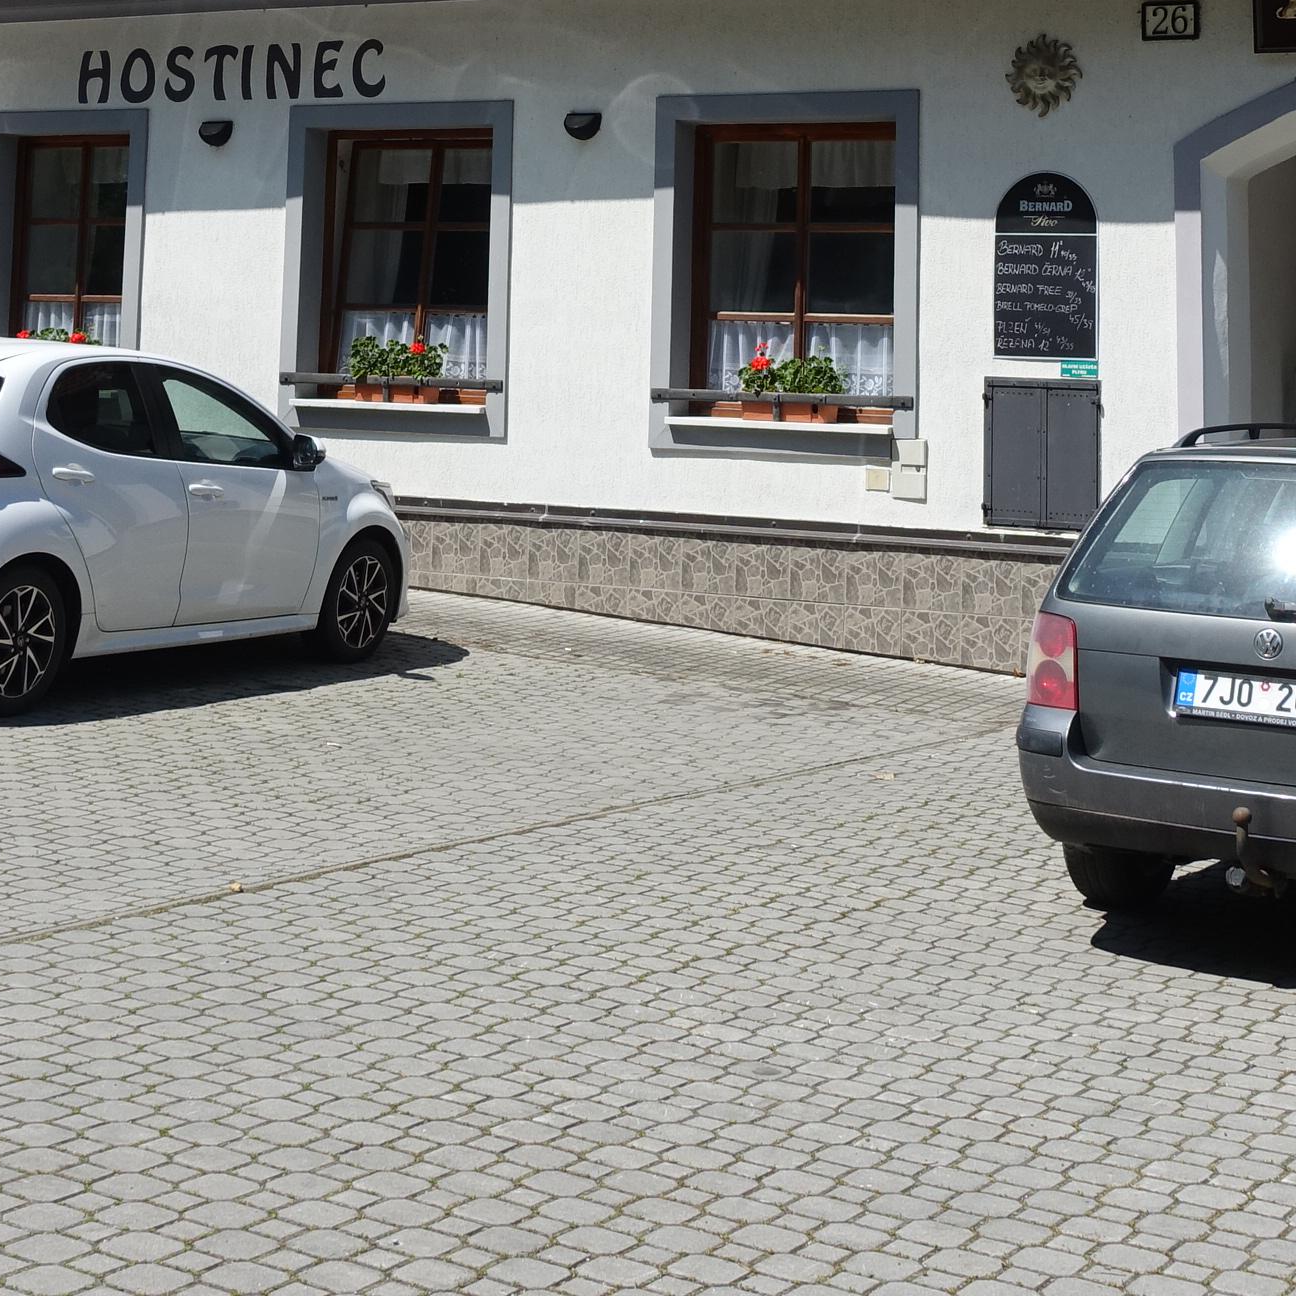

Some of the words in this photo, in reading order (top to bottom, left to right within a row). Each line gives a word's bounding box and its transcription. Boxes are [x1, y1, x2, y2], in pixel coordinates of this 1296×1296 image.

[1151, 6, 1188, 35] 26
[78, 38, 386, 104] HOSTINEC
[1019, 200, 1073, 212] BERNARD
[997, 262, 1039, 275] BERNARD
[996, 283, 1034, 295] BERNARD
[1036, 285, 1063, 296] FREE
[1179, 691, 1194, 702] CZ
[1202, 676, 1254, 707] 7J0
[1192, 708, 1215, 717] MARTIN
[1236, 713, 1257, 722] DOVOZ
[1263, 716, 1287, 725] PRODEJ
